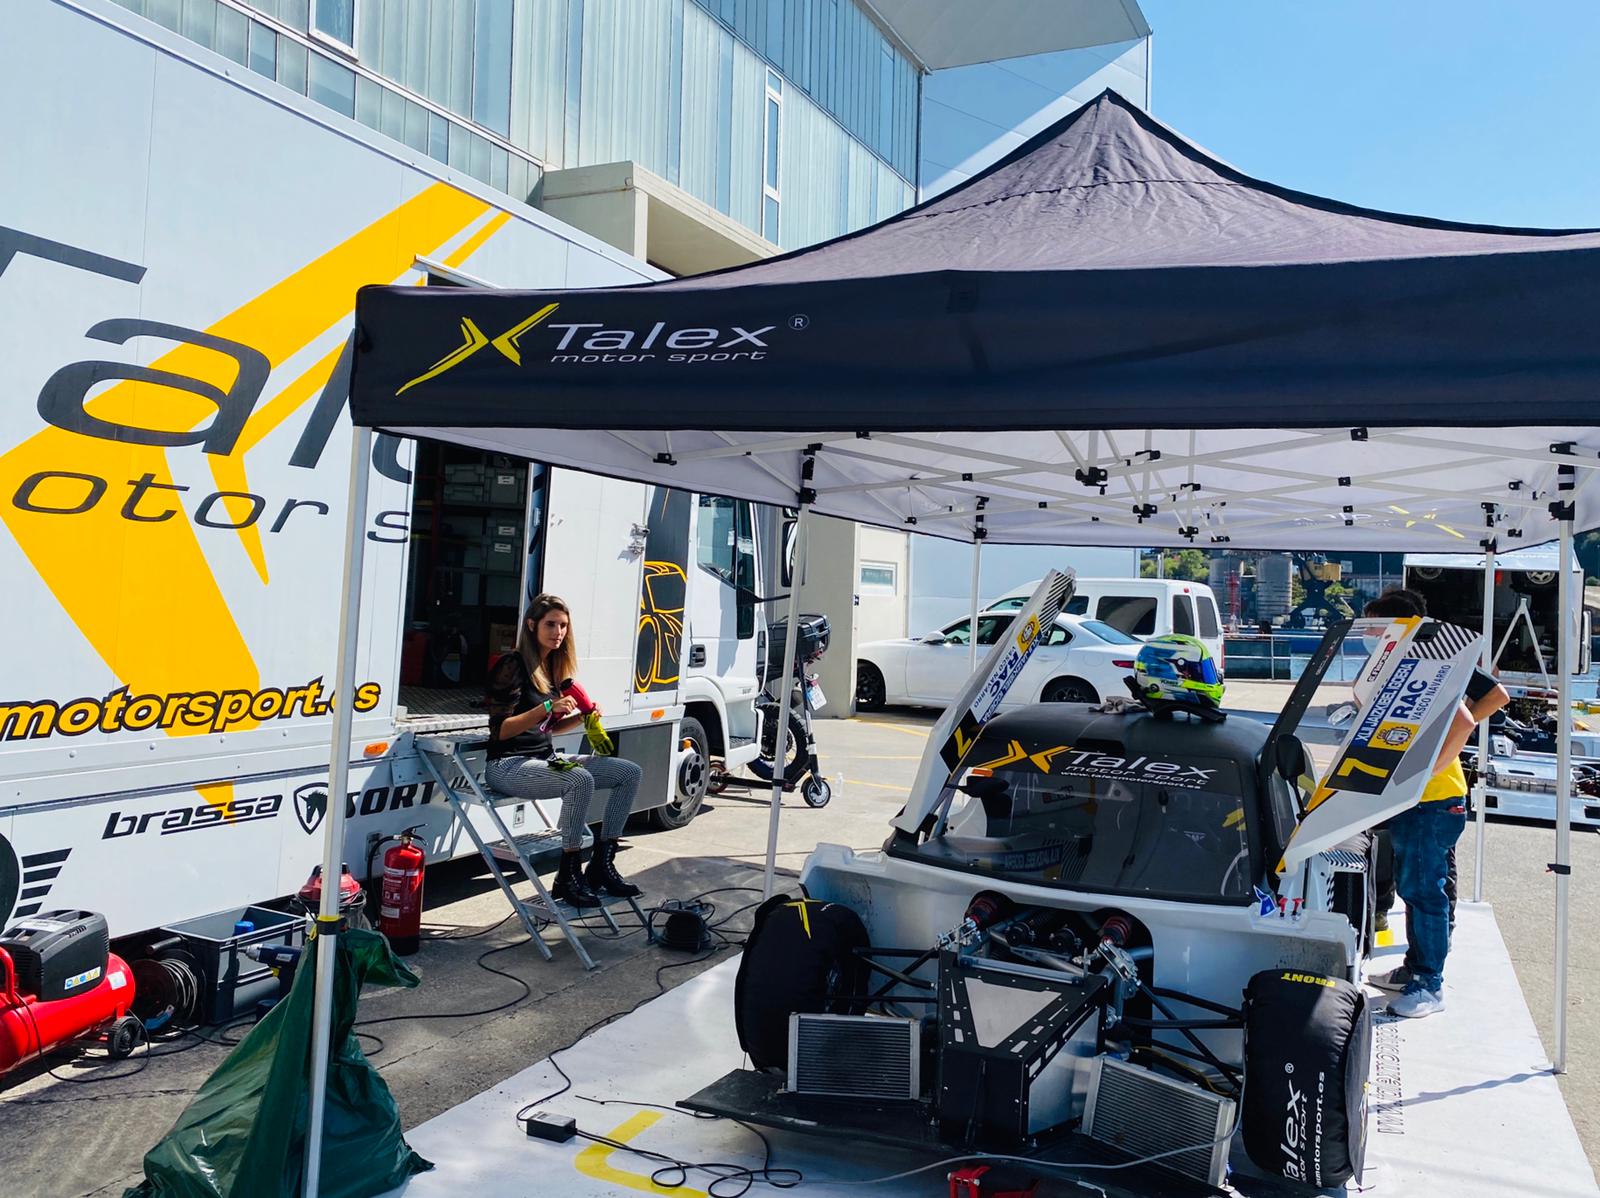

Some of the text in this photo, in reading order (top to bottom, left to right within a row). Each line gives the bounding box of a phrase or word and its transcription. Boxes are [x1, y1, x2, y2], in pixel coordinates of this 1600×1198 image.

[548, 322, 776, 350] Talex
[551, 350, 768, 364] motor sport
[974, 646, 1016, 708] VASCO NAVARRO
[989, 652, 1019, 697] RAC
[1412, 665, 1451, 720] VASCO NAVARRO
[1365, 688, 1399, 729] JAIZKIBEL
[1390, 664, 1415, 690] IGOERA
[1391, 679, 1427, 719] RAC
[1065, 766, 1208, 785] motor sport
[1069, 750, 1218, 779] Talex
[1336, 757, 1390, 779] 7
[101, 794, 283, 840] brassa
[1281, 972, 1336, 987] FRONT
[1299, 1093, 1308, 1150] sport
